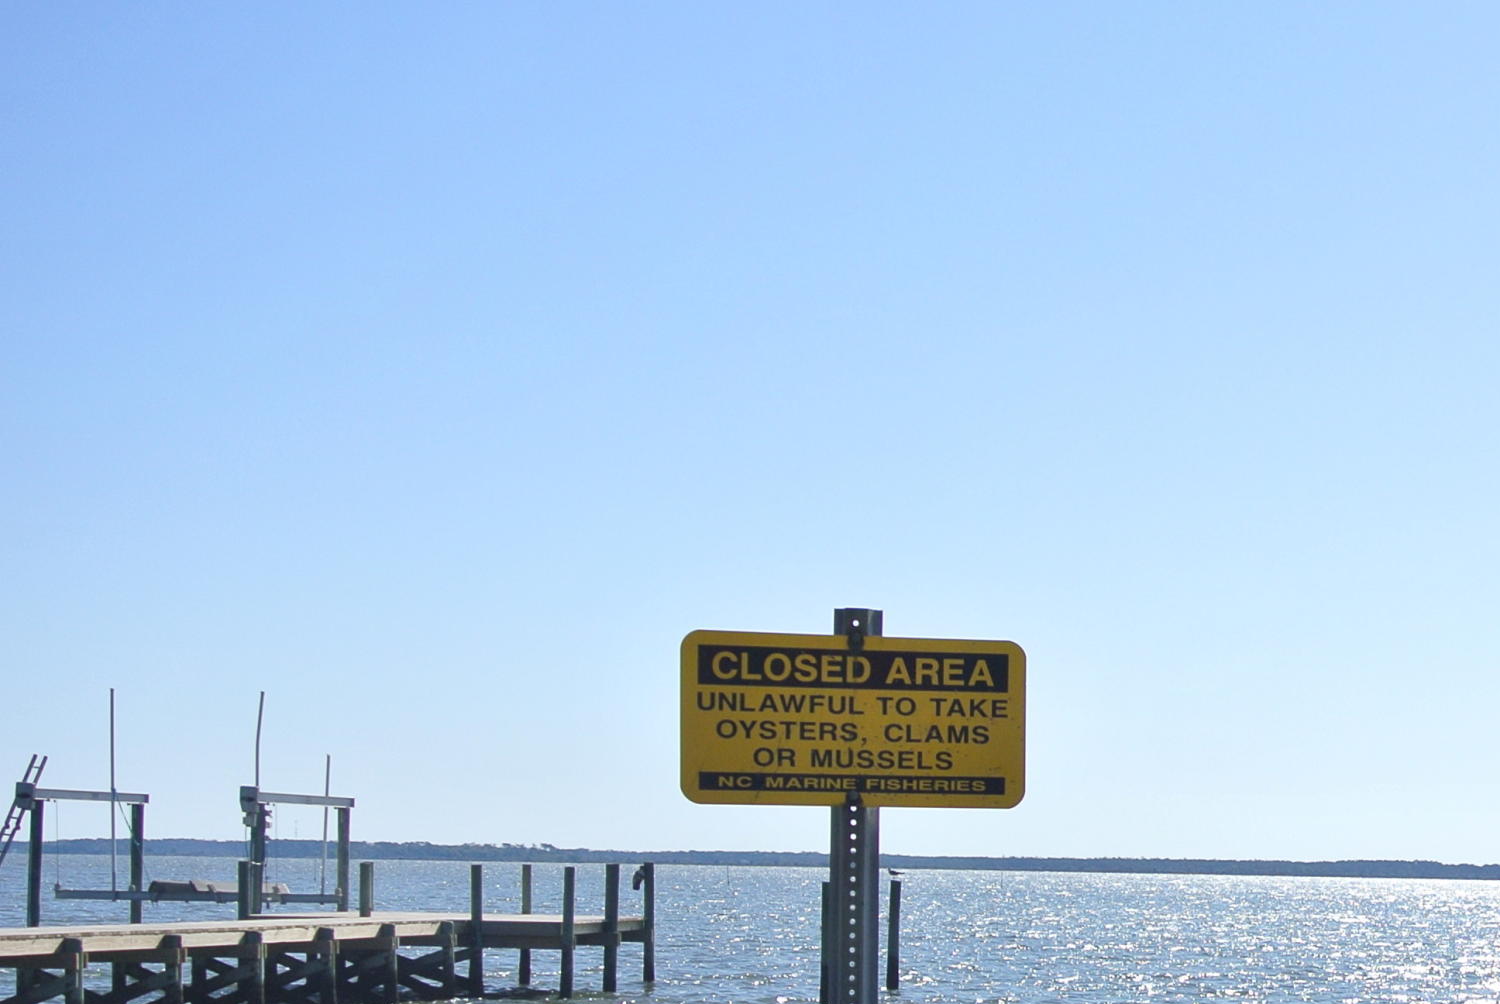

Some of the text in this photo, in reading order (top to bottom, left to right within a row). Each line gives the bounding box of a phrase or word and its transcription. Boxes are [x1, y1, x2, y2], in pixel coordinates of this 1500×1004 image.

[711, 651, 994, 687] CLOSED AREA
[696, 691, 1009, 718] UNLAWFUL TO TAKE
[716, 719, 990, 746] OYSTERS, CLAMS
[753, 747, 953, 770] OR MUSSELS
[718, 776, 986, 792] NC MARINE FISHERIES
